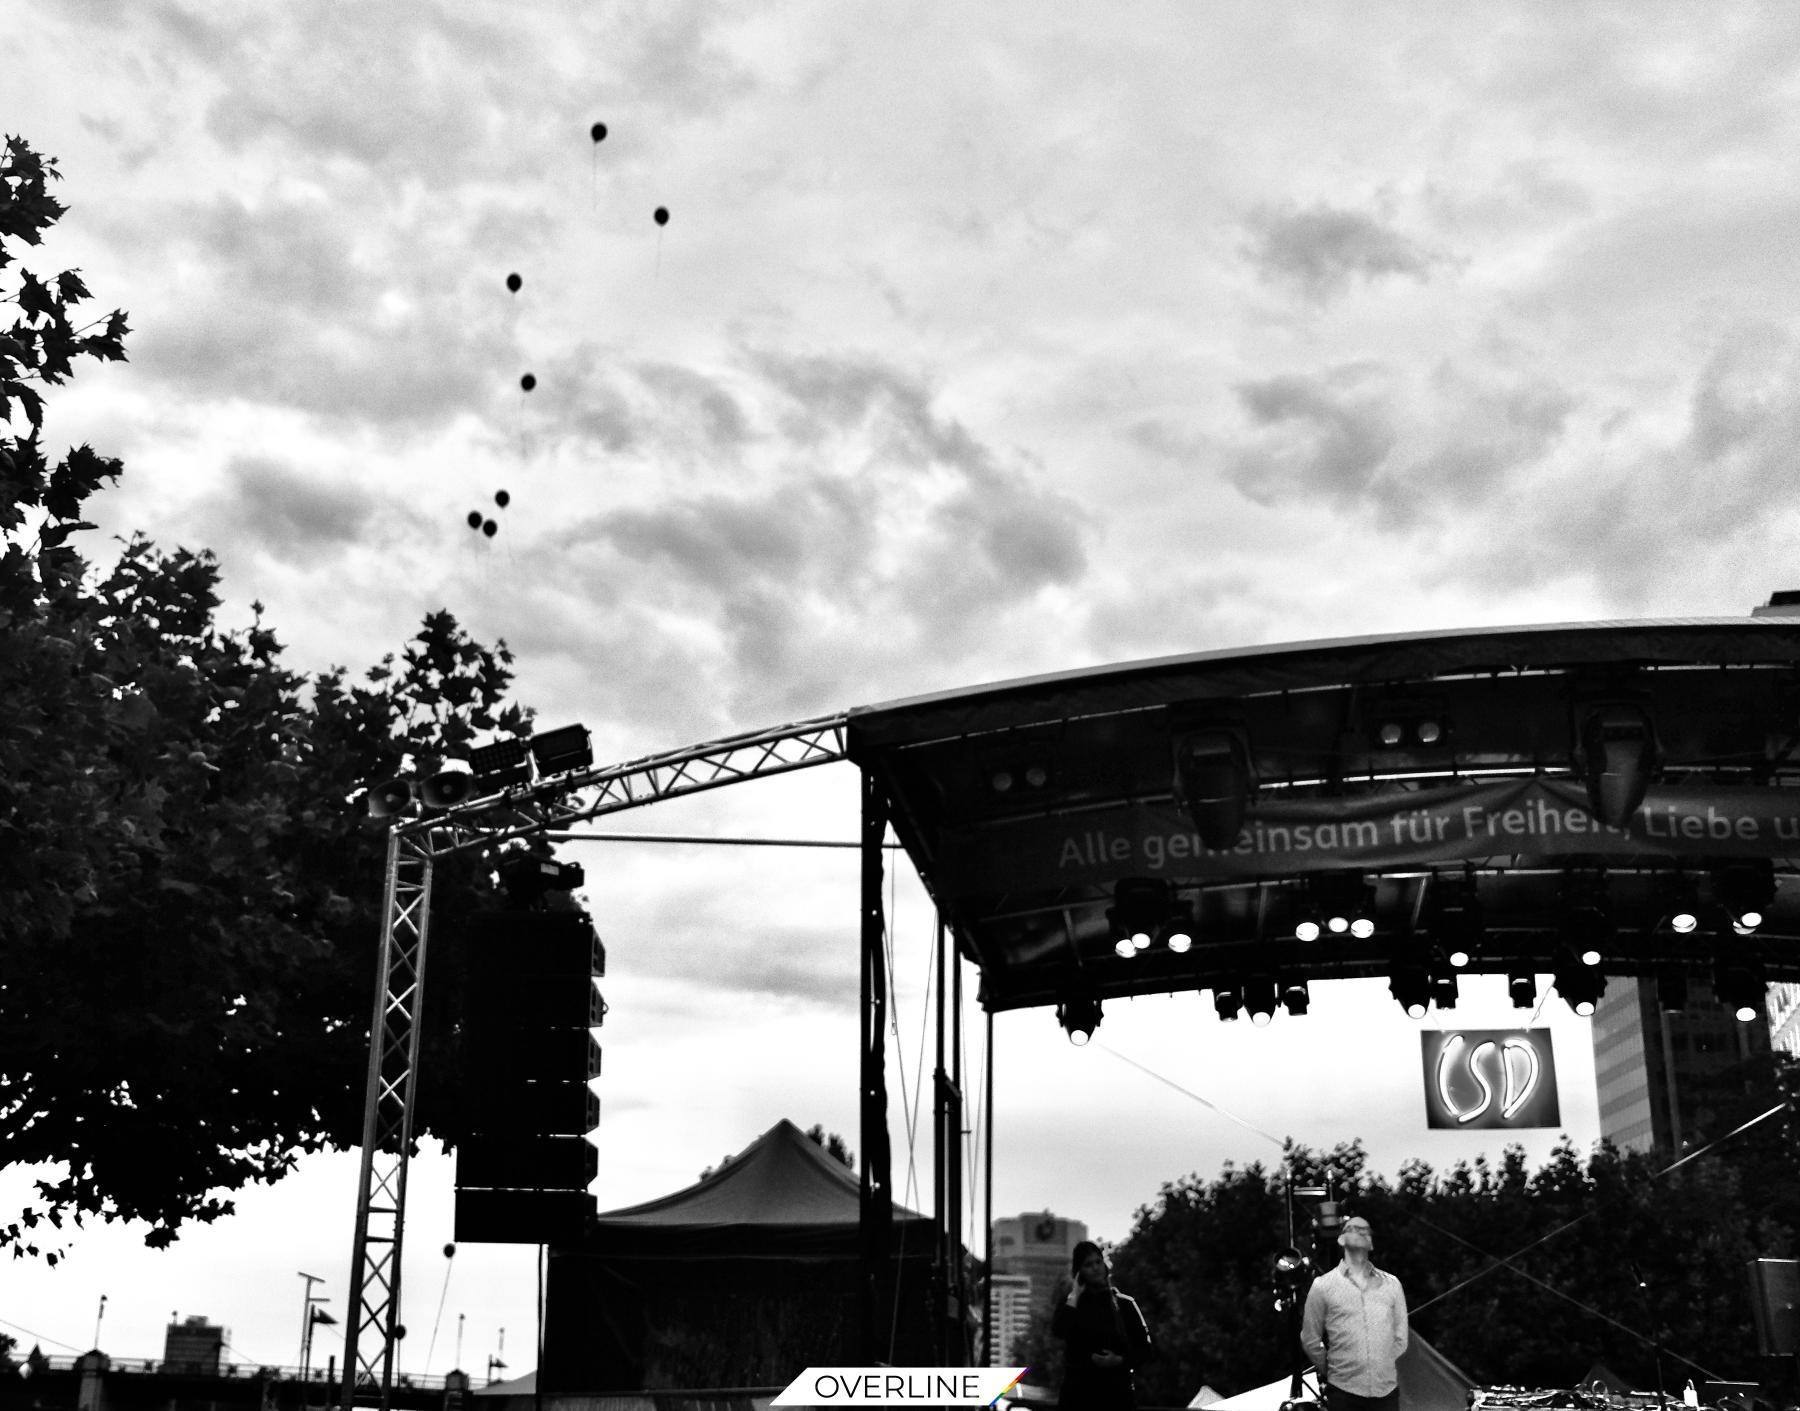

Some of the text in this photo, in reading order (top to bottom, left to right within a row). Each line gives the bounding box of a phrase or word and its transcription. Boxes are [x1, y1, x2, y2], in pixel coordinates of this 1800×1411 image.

[1059, 832, 1131, 867] Alle
[1389, 809, 1450, 843] für
[1643, 805, 1759, 839] Liebe
